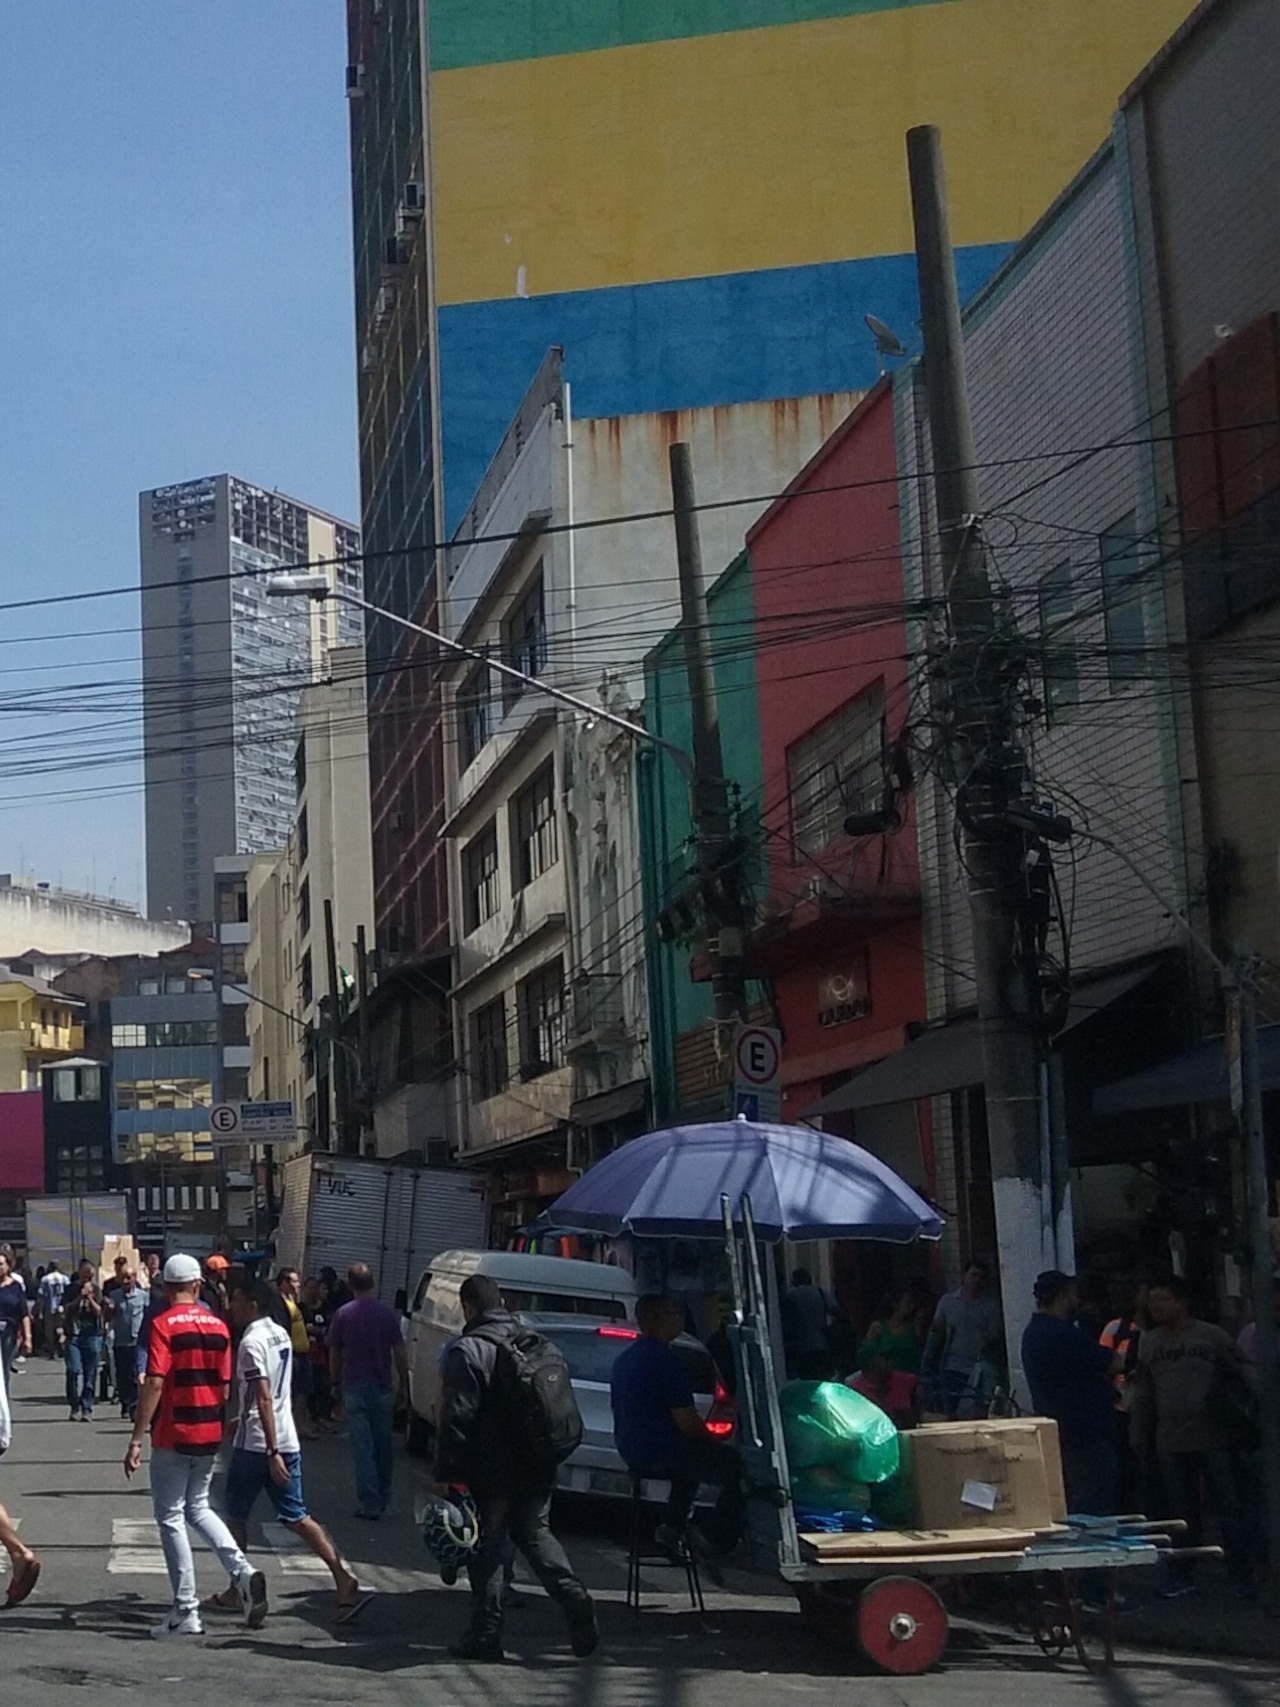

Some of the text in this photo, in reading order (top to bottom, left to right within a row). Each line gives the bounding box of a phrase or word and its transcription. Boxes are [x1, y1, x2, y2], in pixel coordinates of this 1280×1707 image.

[750, 1042, 766, 1072] E
[220, 1112, 230, 1127] E
[167, 1313, 222, 1326] PEUGEOT
[274, 1348, 289, 1400] 7
